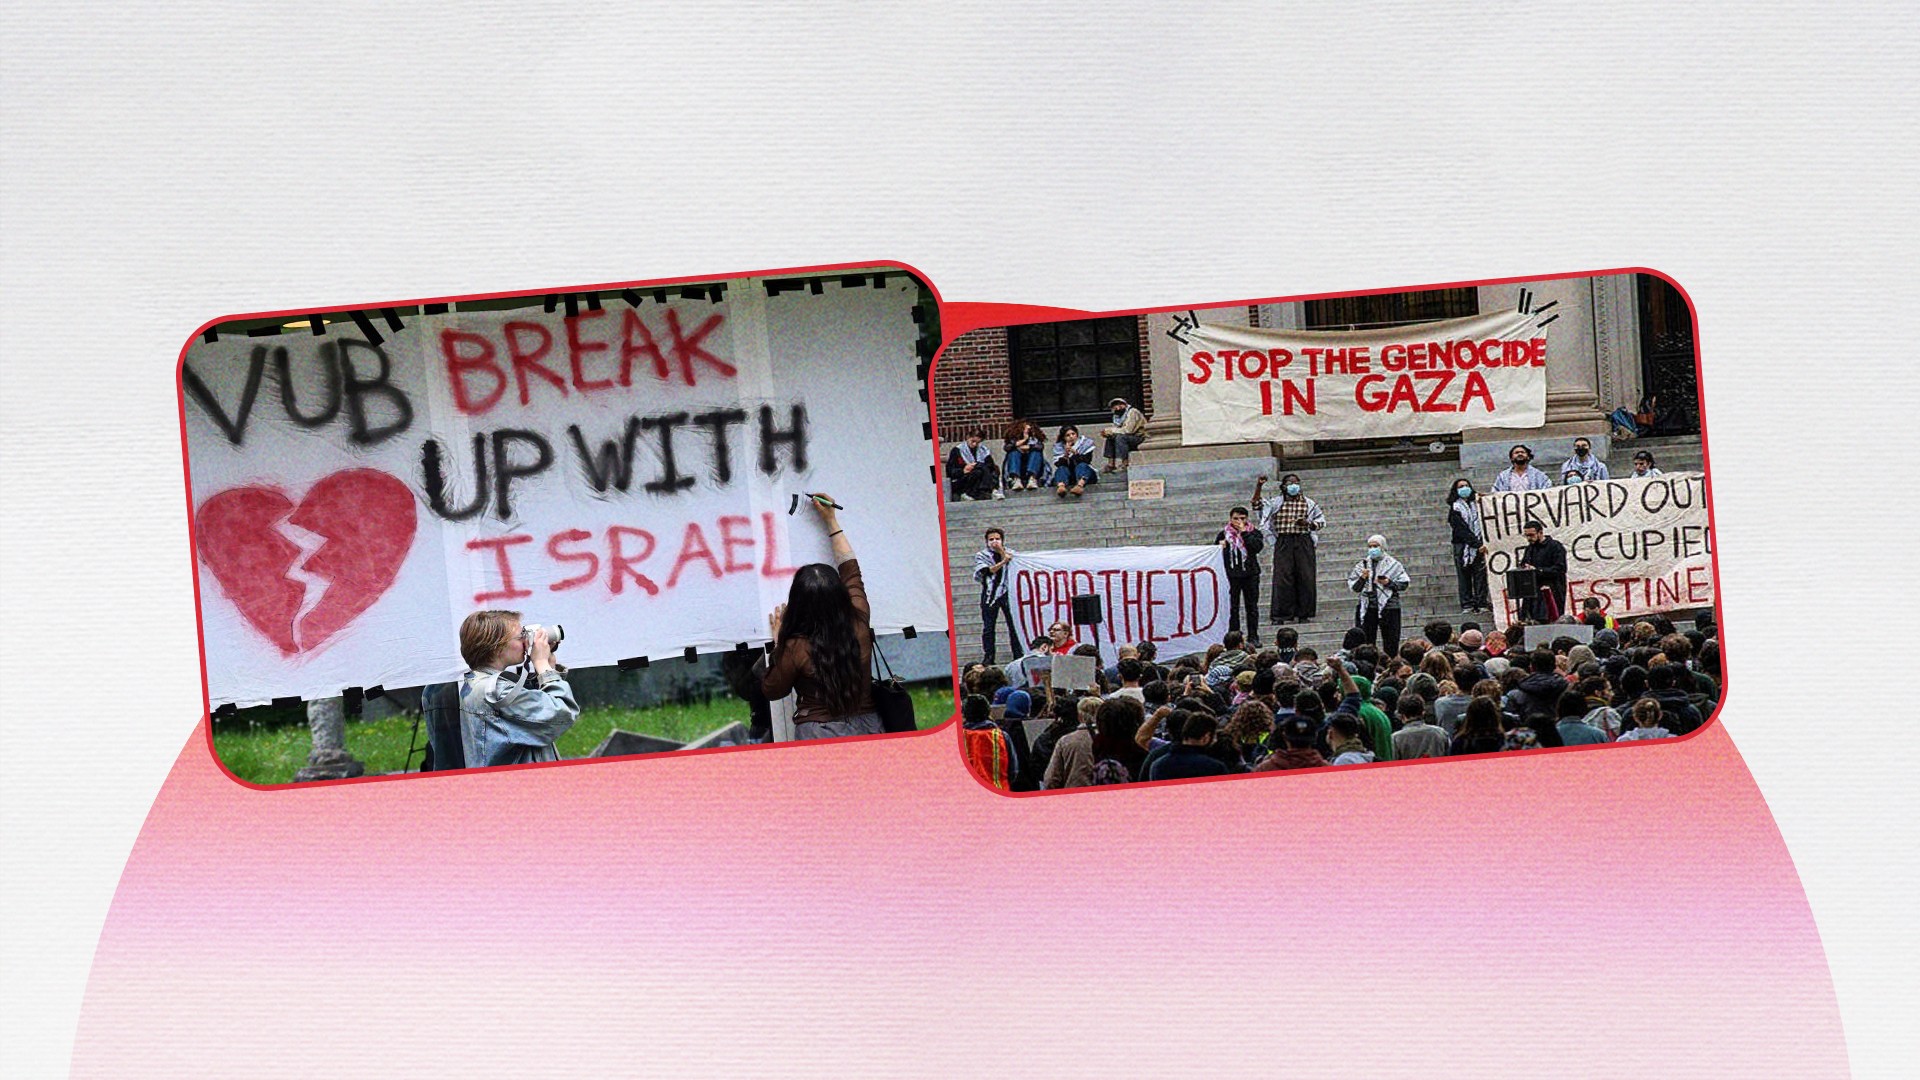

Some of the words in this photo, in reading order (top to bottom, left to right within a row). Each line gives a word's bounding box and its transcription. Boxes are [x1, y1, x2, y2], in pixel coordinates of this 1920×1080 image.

[183, 337, 414, 445] VUB
[441, 308, 738, 415] BREAK
[1187, 348, 1293, 384] STOP
[1301, 347, 1371, 376] THE
[1381, 338, 1546, 372] GENOCIDE
[1260, 378, 1317, 415] IN
[1355, 370, 1495, 413] GAZA
[422, 429, 555, 521] UP
[567, 403, 807, 492] WITH
[1480, 481, 1628, 542] HARVARD
[1641, 476, 1707, 513] OUT
[1571, 526, 1712, 562] CCUPIE
[466, 511, 800, 603] ISRAEL
[1016, 567, 1219, 650] APARTHEID
